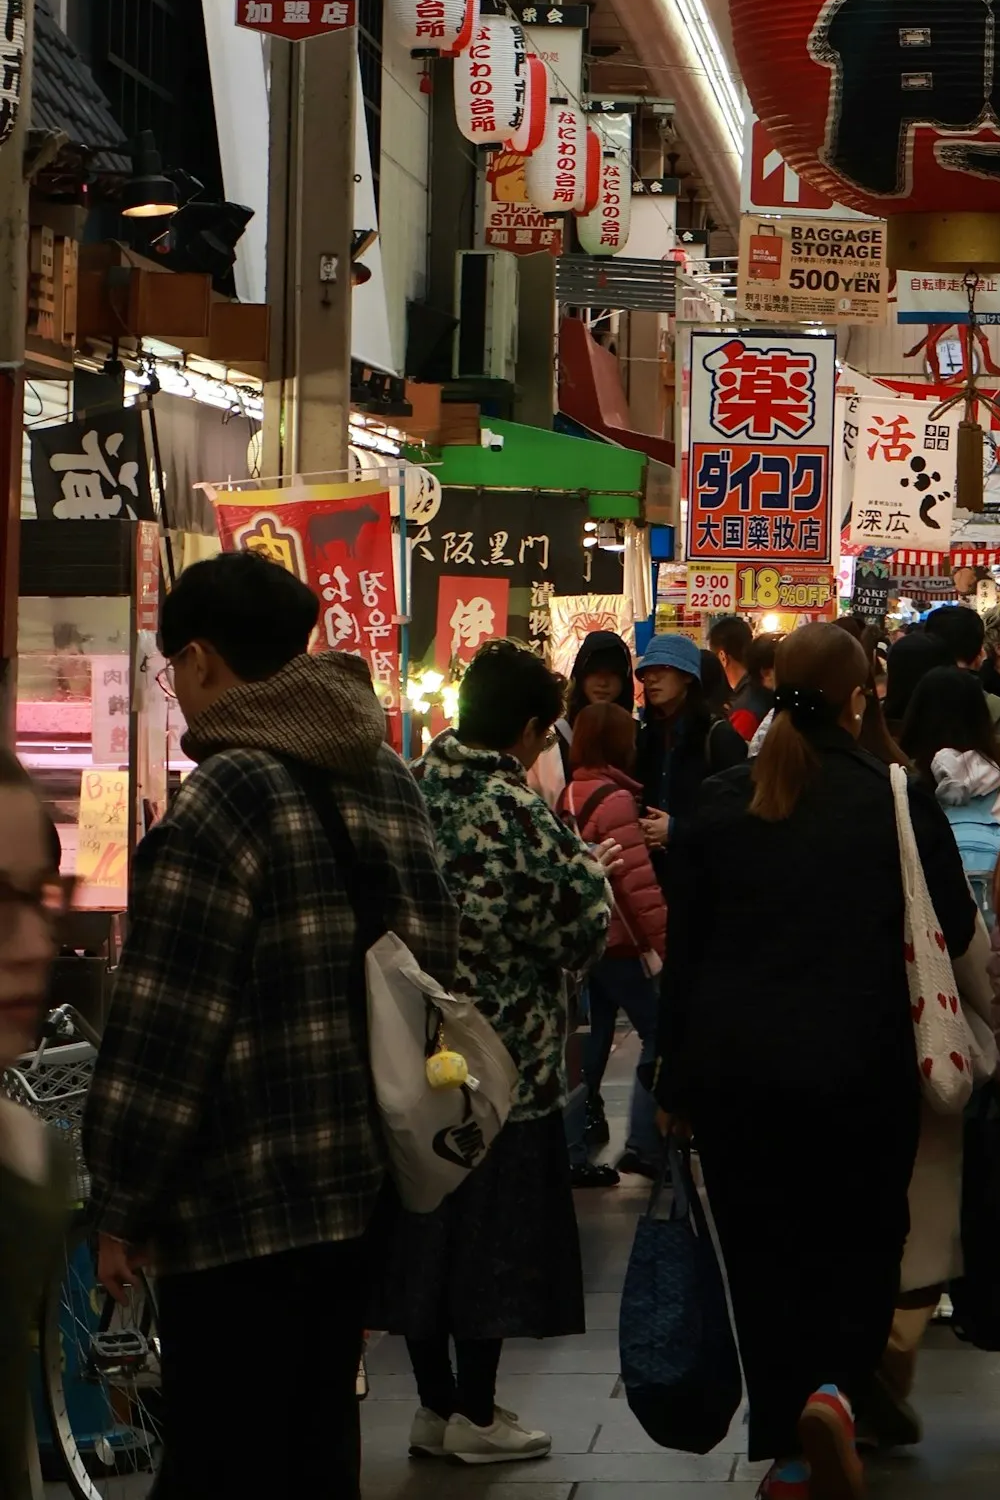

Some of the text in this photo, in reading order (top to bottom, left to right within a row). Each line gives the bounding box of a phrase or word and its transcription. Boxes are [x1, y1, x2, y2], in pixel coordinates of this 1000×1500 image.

[245, 1, 349, 25] 加盟店
[469, 26, 496, 132] なにわの台所
[553, 111, 577, 203] なにわの台所
[496, 202, 542, 214] フレッシ
[600, 165, 621, 247] なにわの台所
[490, 213, 558, 227] STAMP
[490, 229, 558, 245] 加盟店
[791, 226, 882, 244] BAGGAGE
[791, 242, 882, 259] STORAGE
[789, 269, 880, 293] 500 YEN
[703, 340, 816, 440] 薬
[866, 415, 916, 462] 活
[697, 449, 825, 512] ダイコク
[900, 455, 951, 530] ふぐ
[857, 509, 911, 534] 深広
[695, 575, 729, 589] 9:00
[856, 587, 887, 598] TAKE
[691, 594, 731, 608] 22:00
[853, 604, 887, 615] COFFEE
[858, 597, 882, 605] OUT
